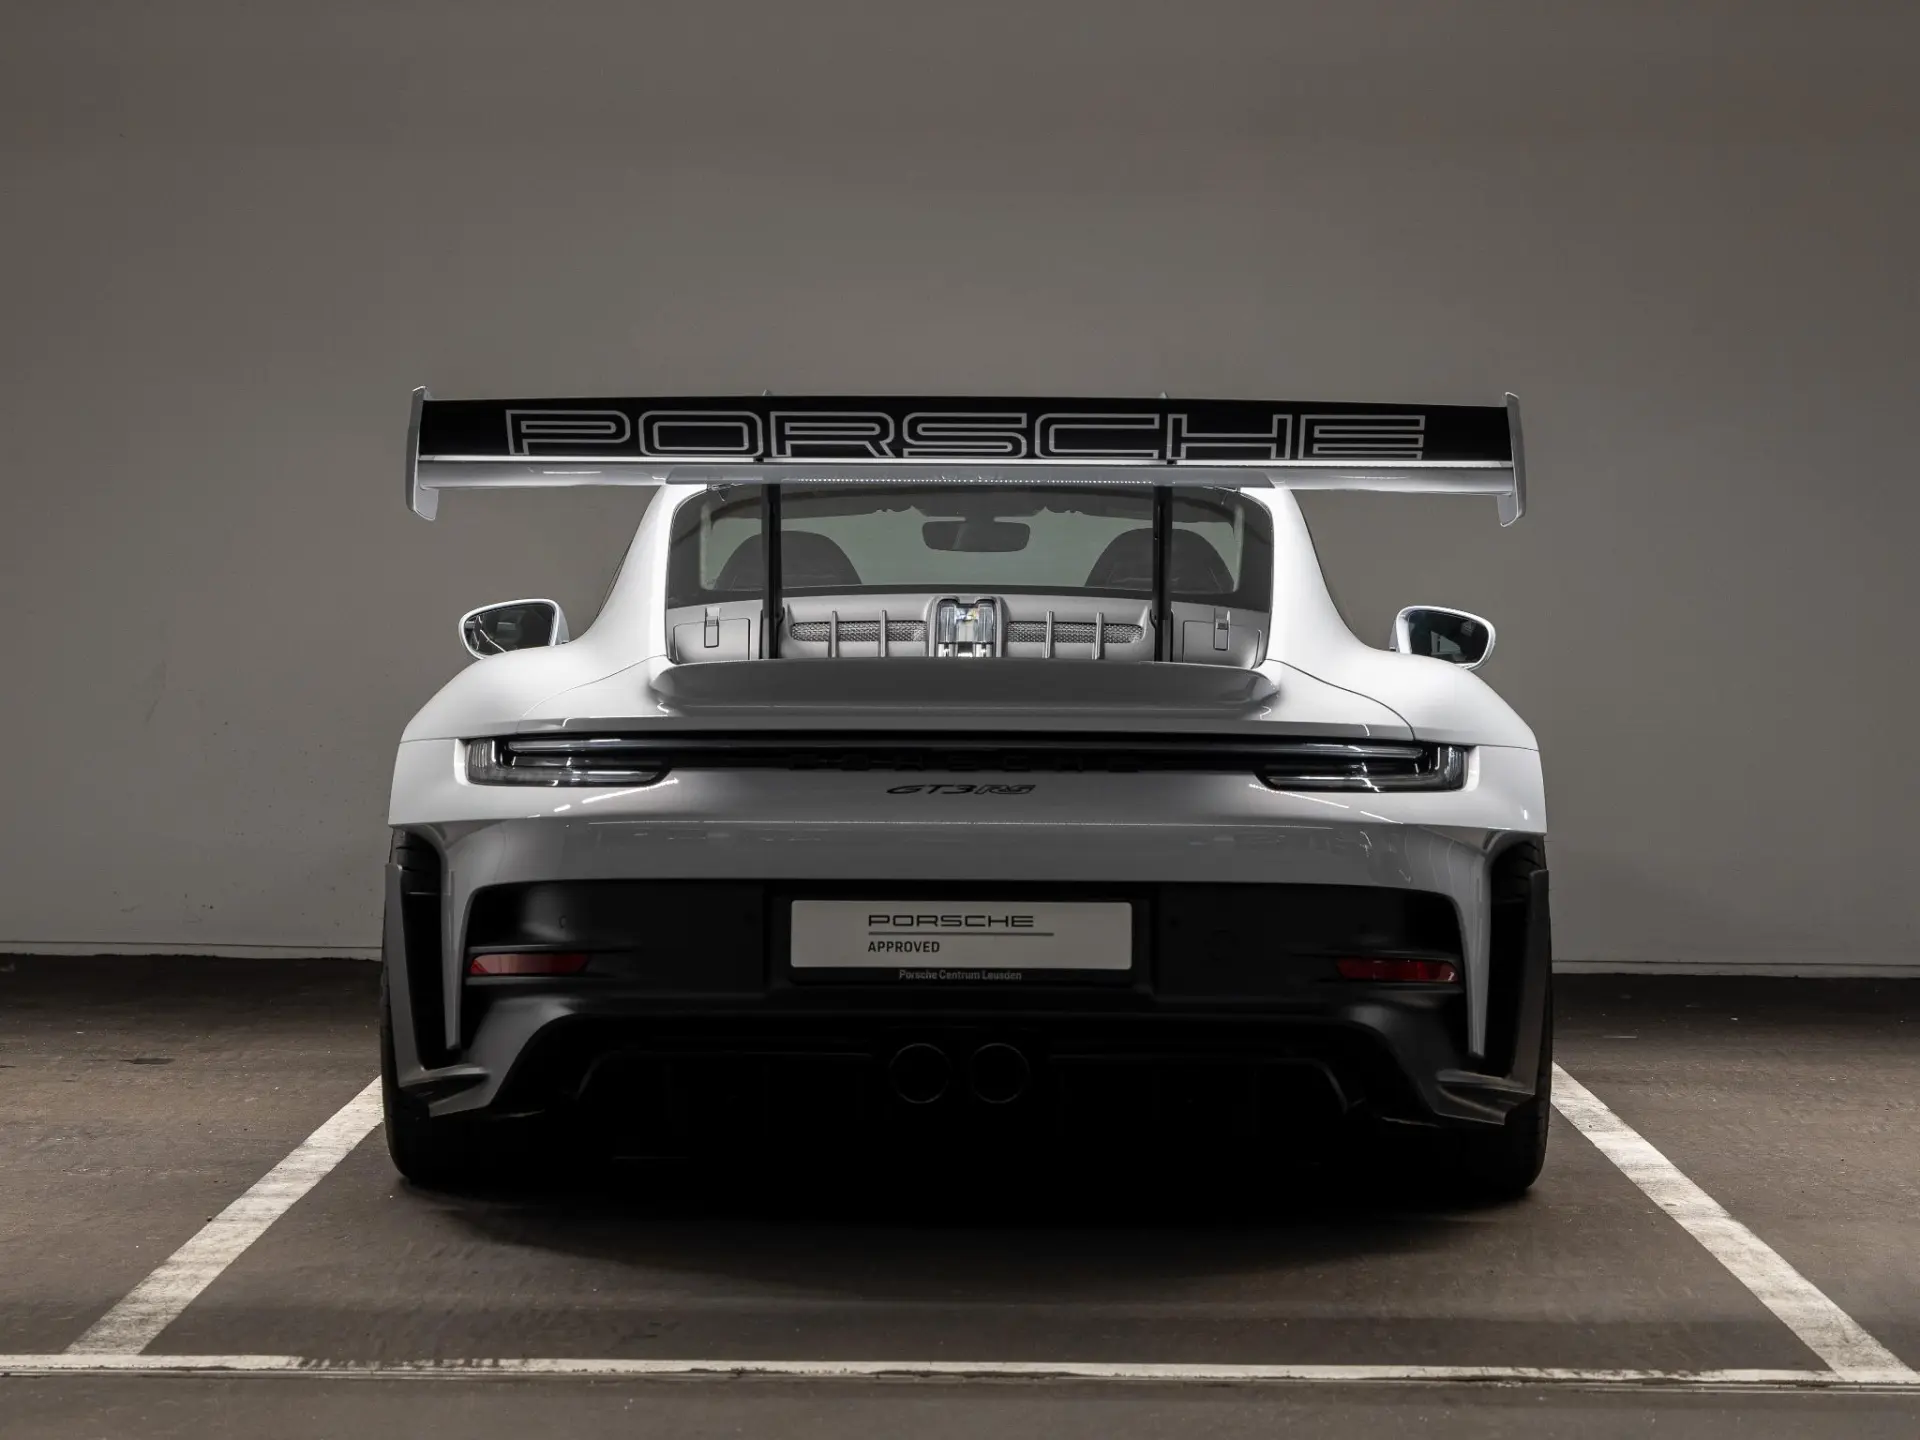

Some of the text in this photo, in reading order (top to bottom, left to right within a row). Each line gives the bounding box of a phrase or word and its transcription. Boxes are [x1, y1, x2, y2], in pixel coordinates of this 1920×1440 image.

[505, 409, 1426, 461] PORSCHE
[868, 914, 1034, 928] PORSCHE
[867, 940, 941, 953] APPROVED
[899, 968, 938, 980] Porsche
[939, 968, 981, 980] Centrum
